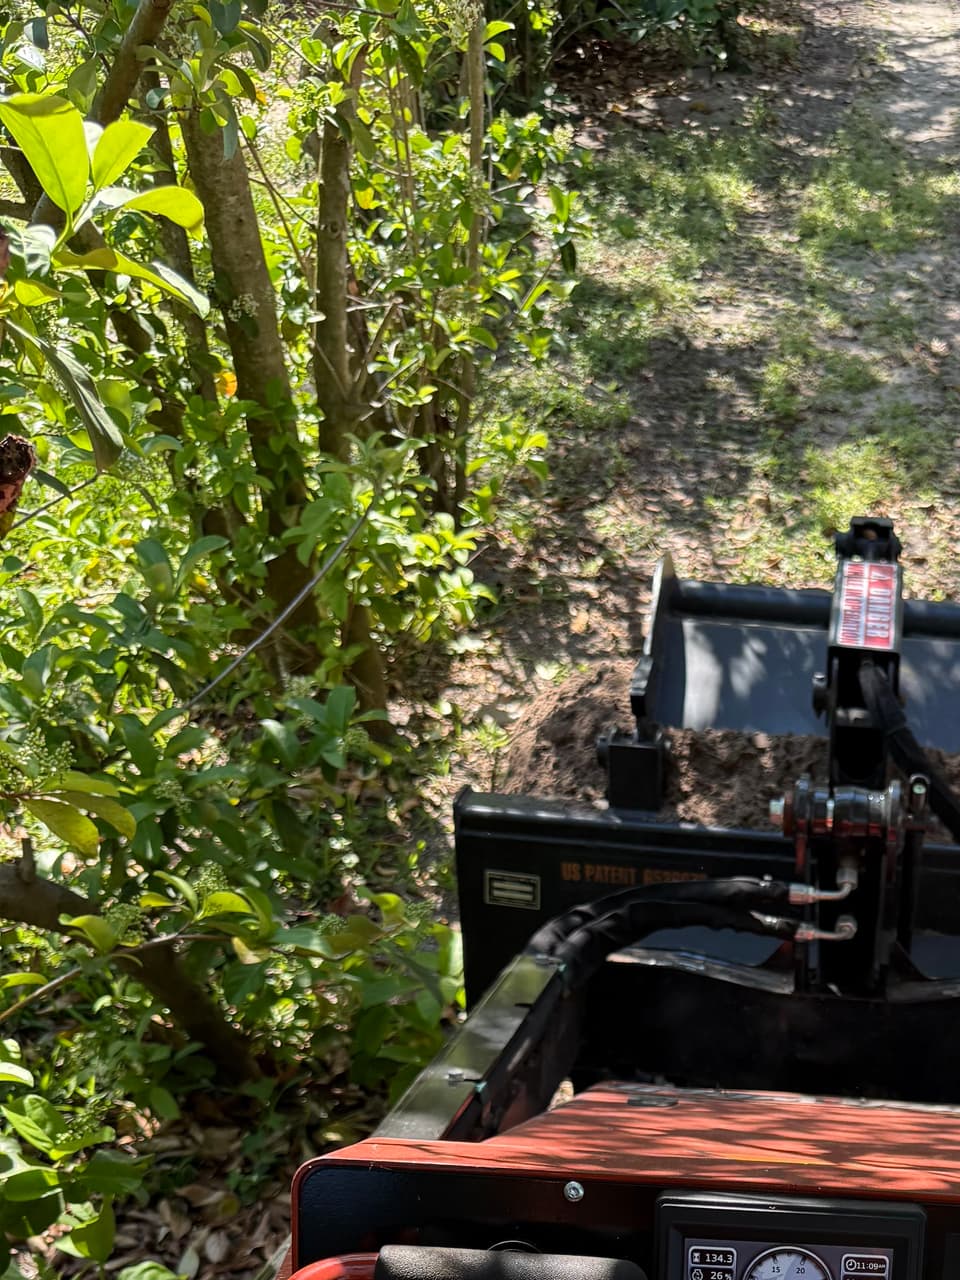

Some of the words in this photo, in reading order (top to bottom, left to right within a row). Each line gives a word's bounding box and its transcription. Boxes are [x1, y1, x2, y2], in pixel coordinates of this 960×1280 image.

[866, 588, 891, 638] DANGER
[560, 862, 580, 881] US
[584, 864, 637, 885] PATENT
[705, 1253, 733, 1263] 134.3
[710, 1271, 723, 1280] 26
